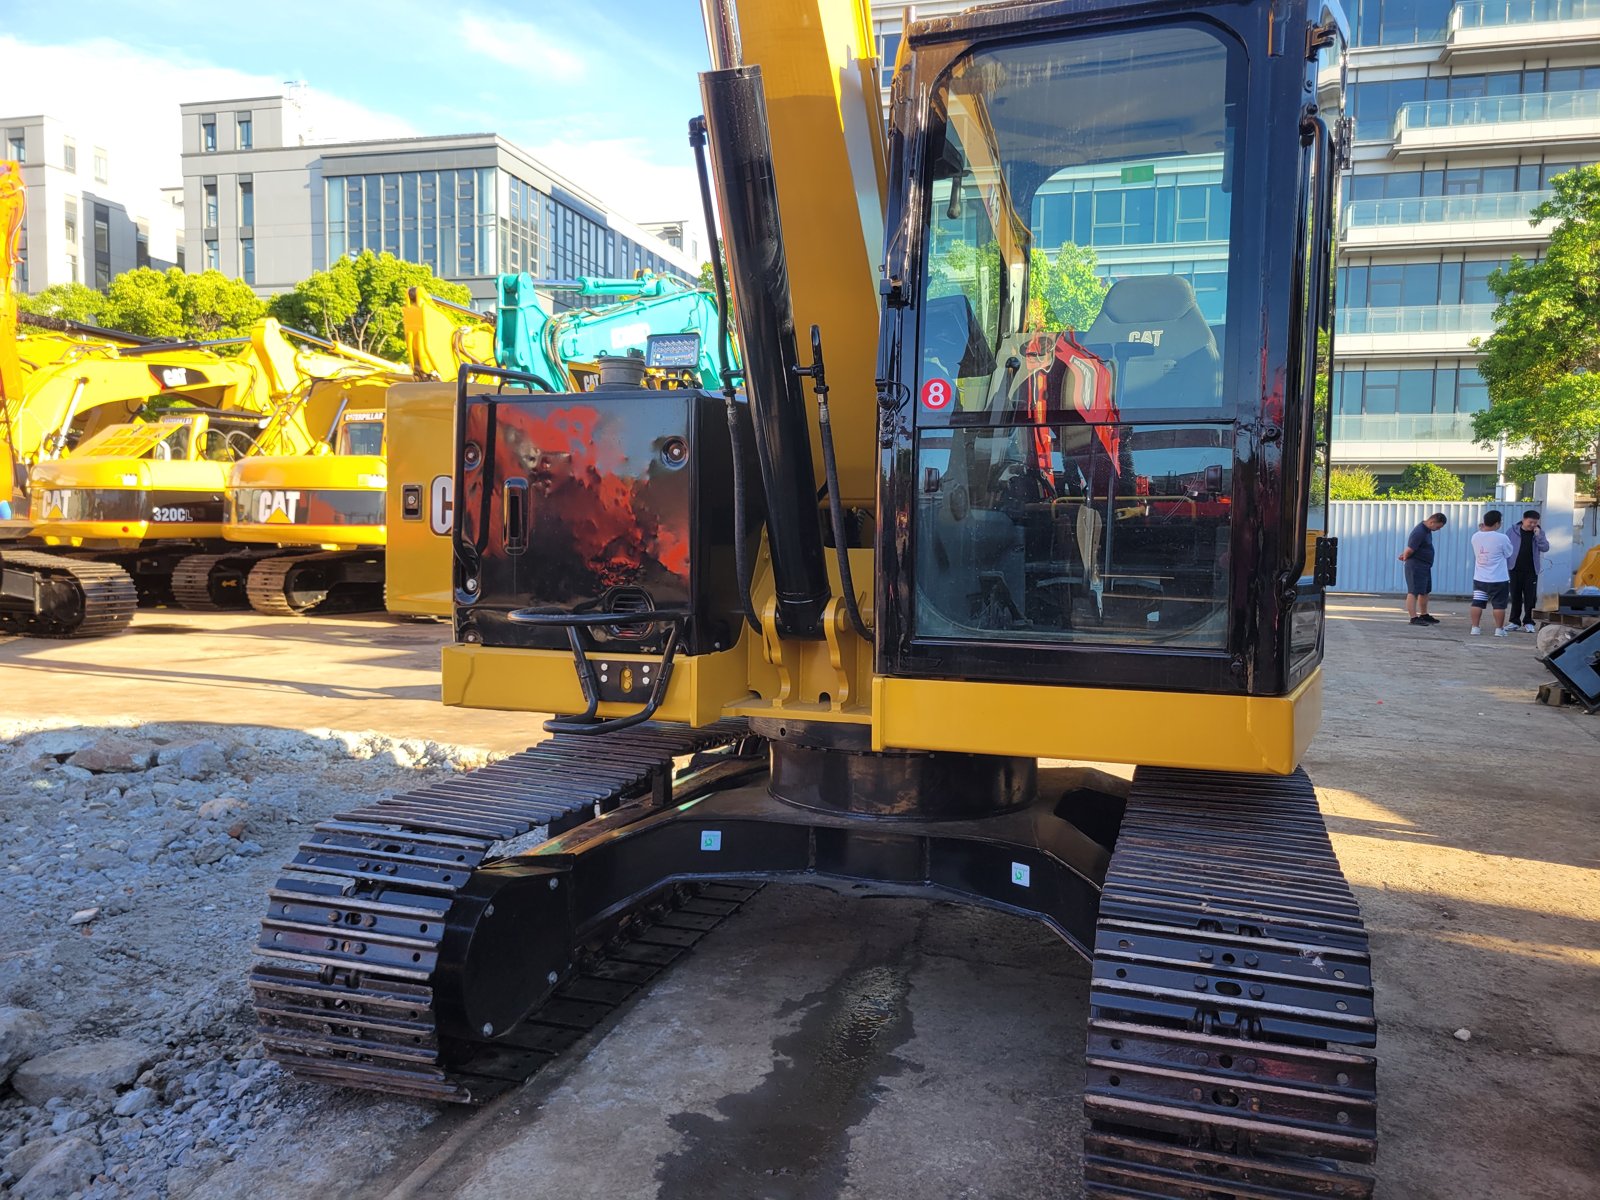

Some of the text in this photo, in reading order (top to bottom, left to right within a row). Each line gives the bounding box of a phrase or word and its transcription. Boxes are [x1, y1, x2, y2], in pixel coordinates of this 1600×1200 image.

[1128, 330, 1164, 347] CAT
[928, 382, 945, 406] 8
[42, 490, 72, 519] CAT
[258, 491, 301, 524] CAT
